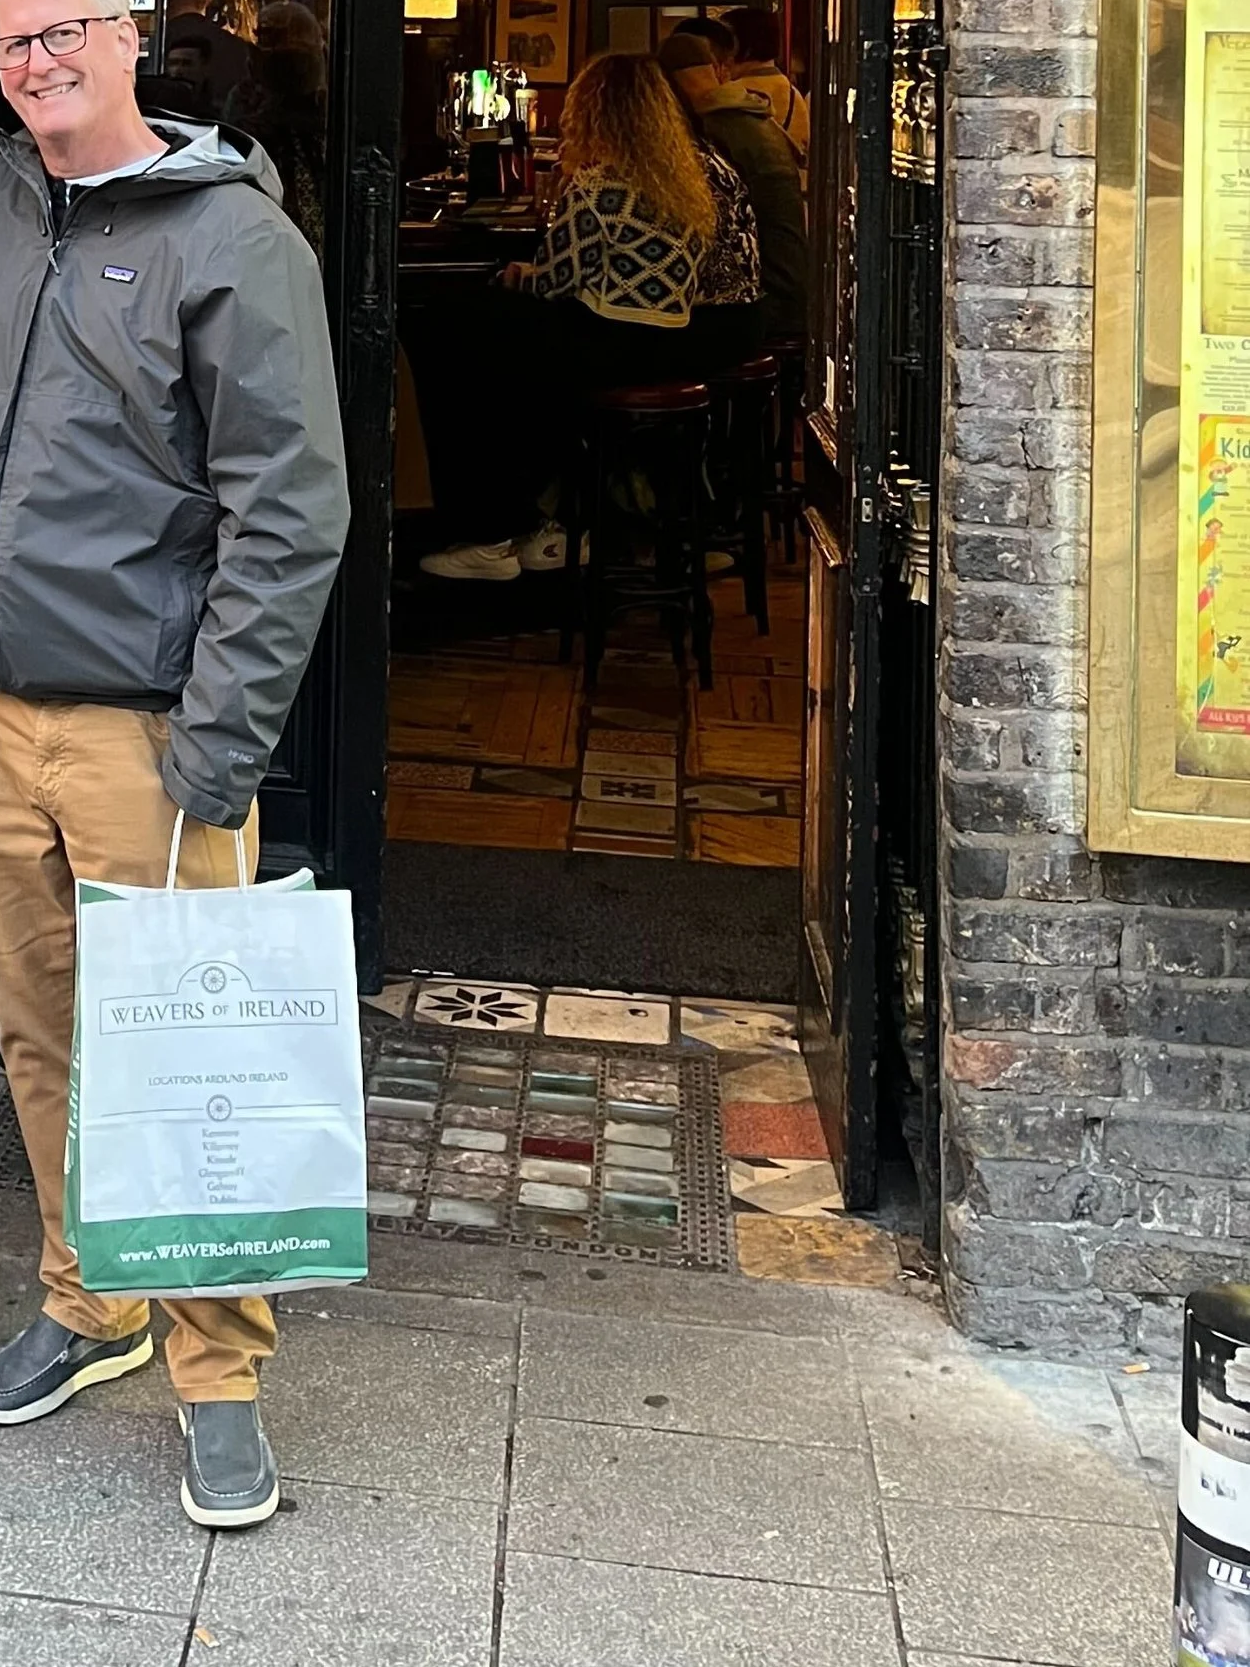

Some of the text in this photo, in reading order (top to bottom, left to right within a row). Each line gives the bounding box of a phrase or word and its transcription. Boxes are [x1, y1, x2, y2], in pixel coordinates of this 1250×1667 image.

[111, 1001, 204, 1025] WEAVERS
[239, 999, 326, 1018] IRELAND
[148, 1071, 289, 1086] LOCATIONS AROUND IRELAND
[509, 1234, 658, 1260] LONDON
[1207, 1556, 1250, 1590] UL
